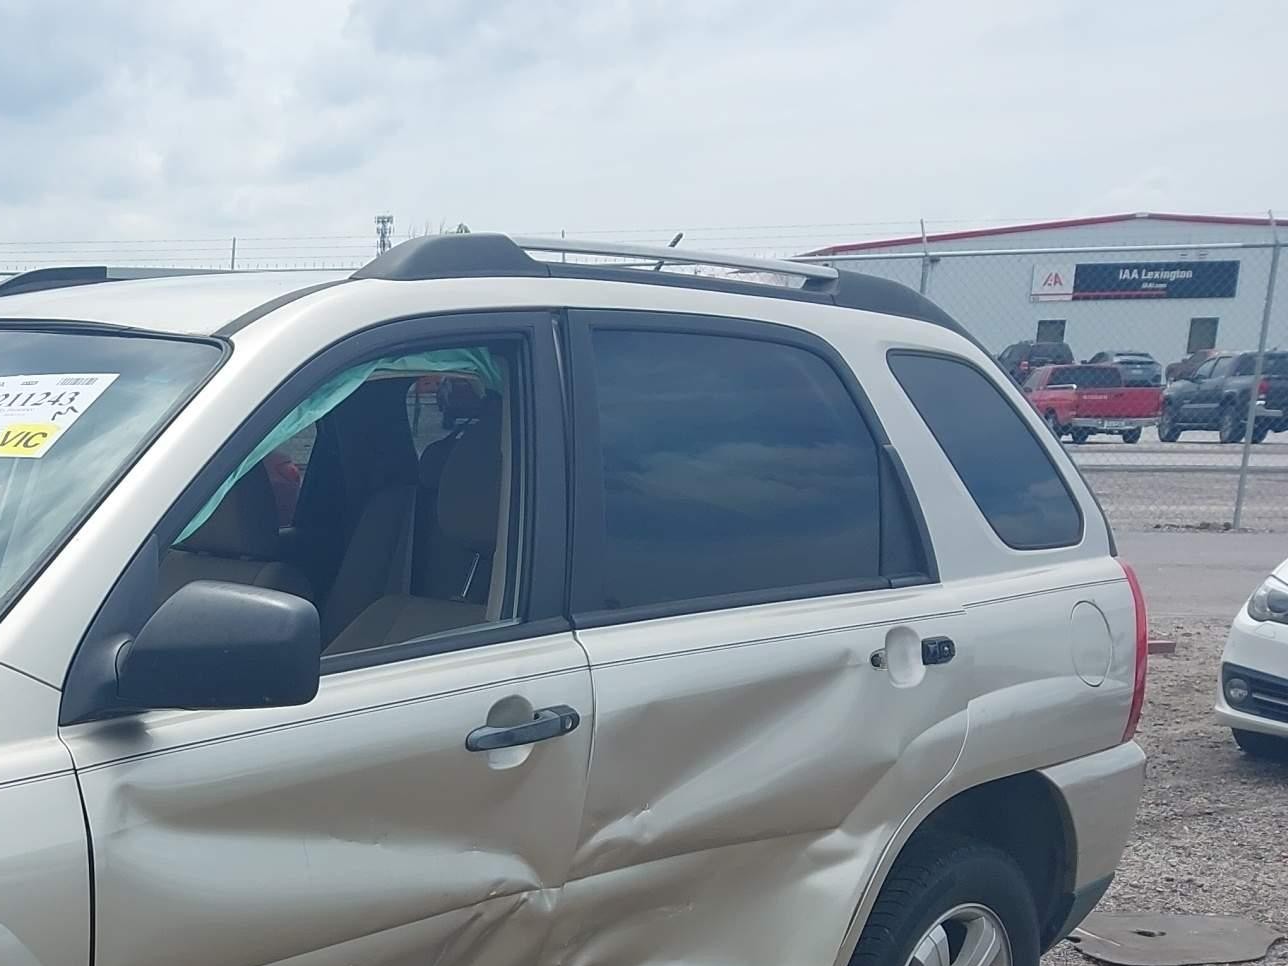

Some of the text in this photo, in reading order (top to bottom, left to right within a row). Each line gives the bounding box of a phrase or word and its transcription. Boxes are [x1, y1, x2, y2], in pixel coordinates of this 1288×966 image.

[1119, 267, 1193, 281] IAA Lexington
[0, 429, 47, 449] VIC
